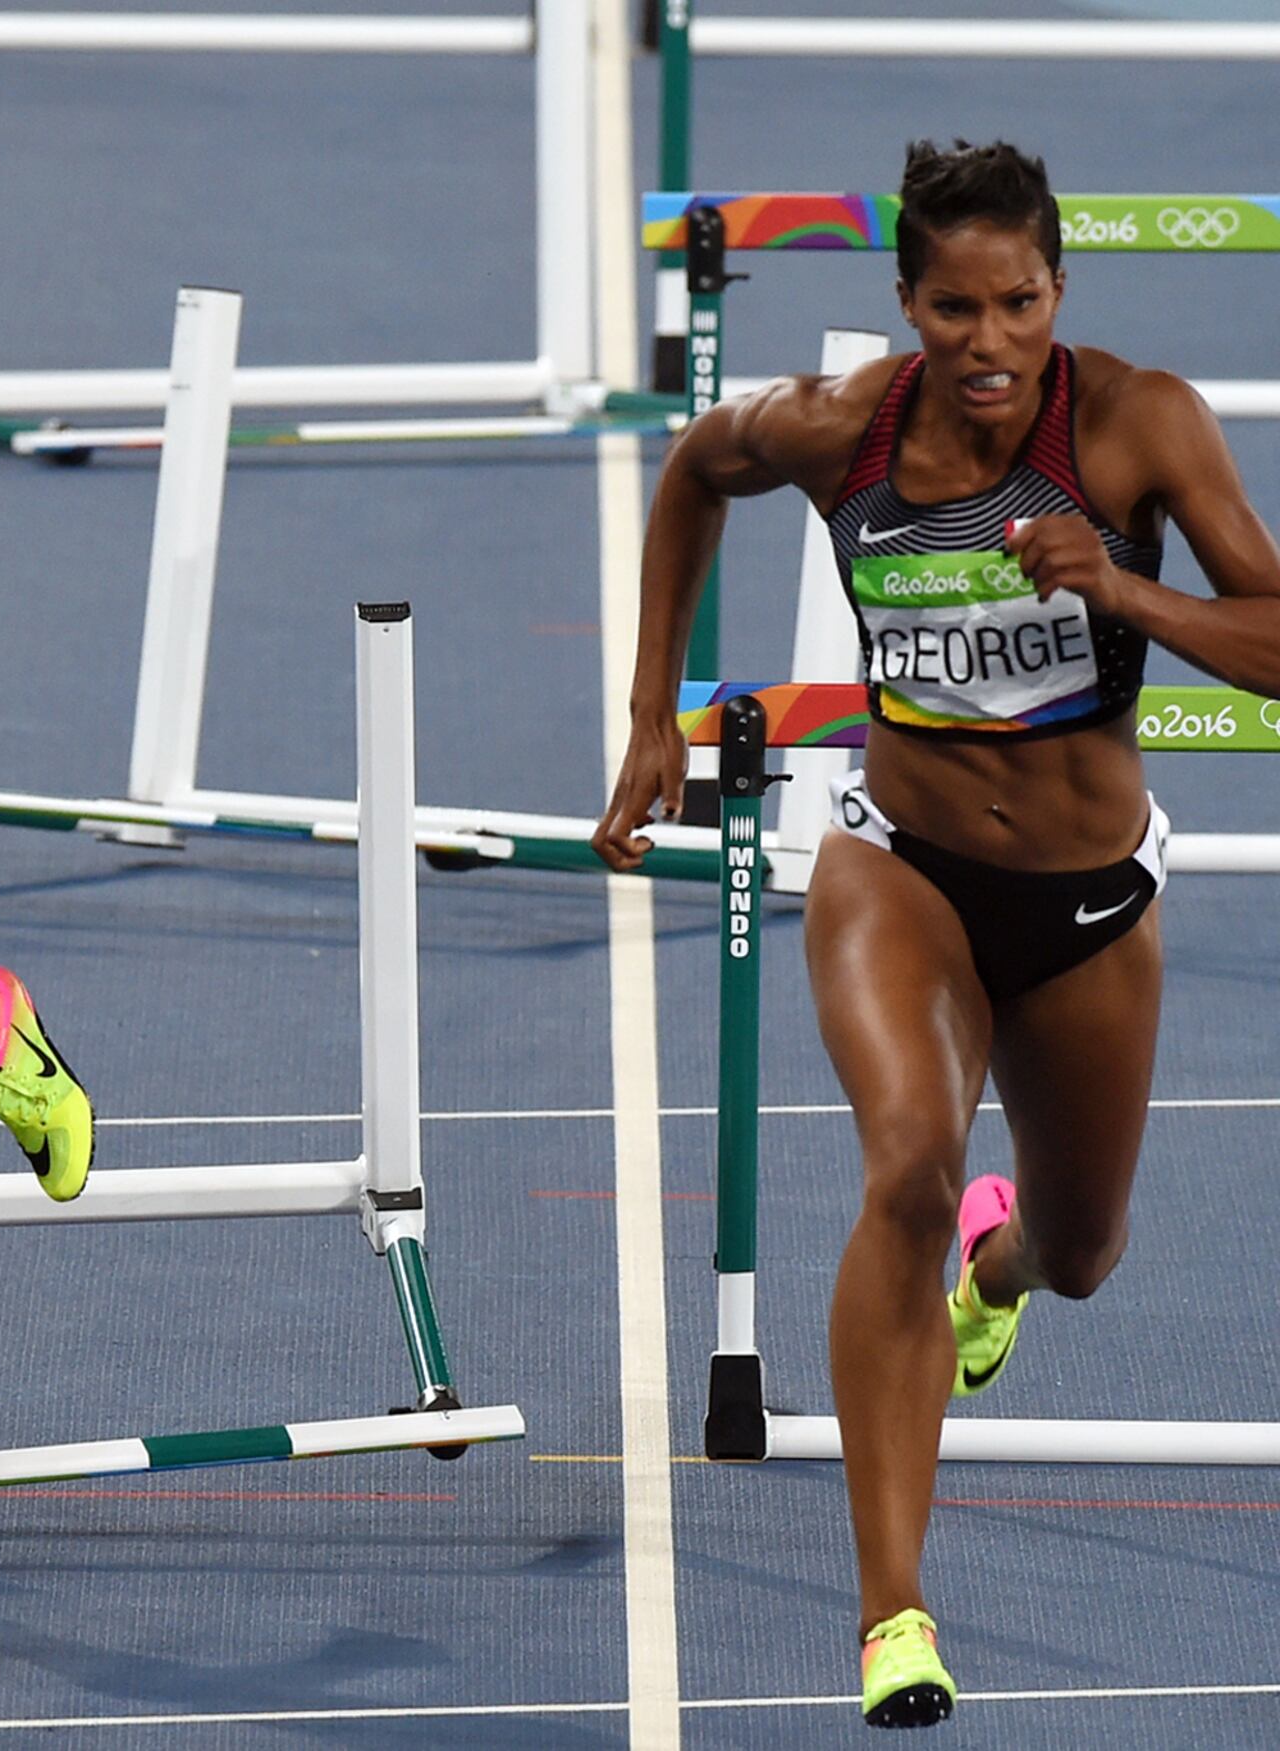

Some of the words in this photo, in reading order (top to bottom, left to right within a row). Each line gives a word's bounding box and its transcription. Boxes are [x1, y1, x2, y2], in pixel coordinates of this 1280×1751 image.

[1060, 211, 1138, 243] o2016
[691, 335, 718, 414] MOND
[883, 569, 971, 596] Rio2016
[878, 614, 1089, 686] GEORGE
[1135, 704, 1237, 738] o2016
[727, 846, 755, 958] MONDO
